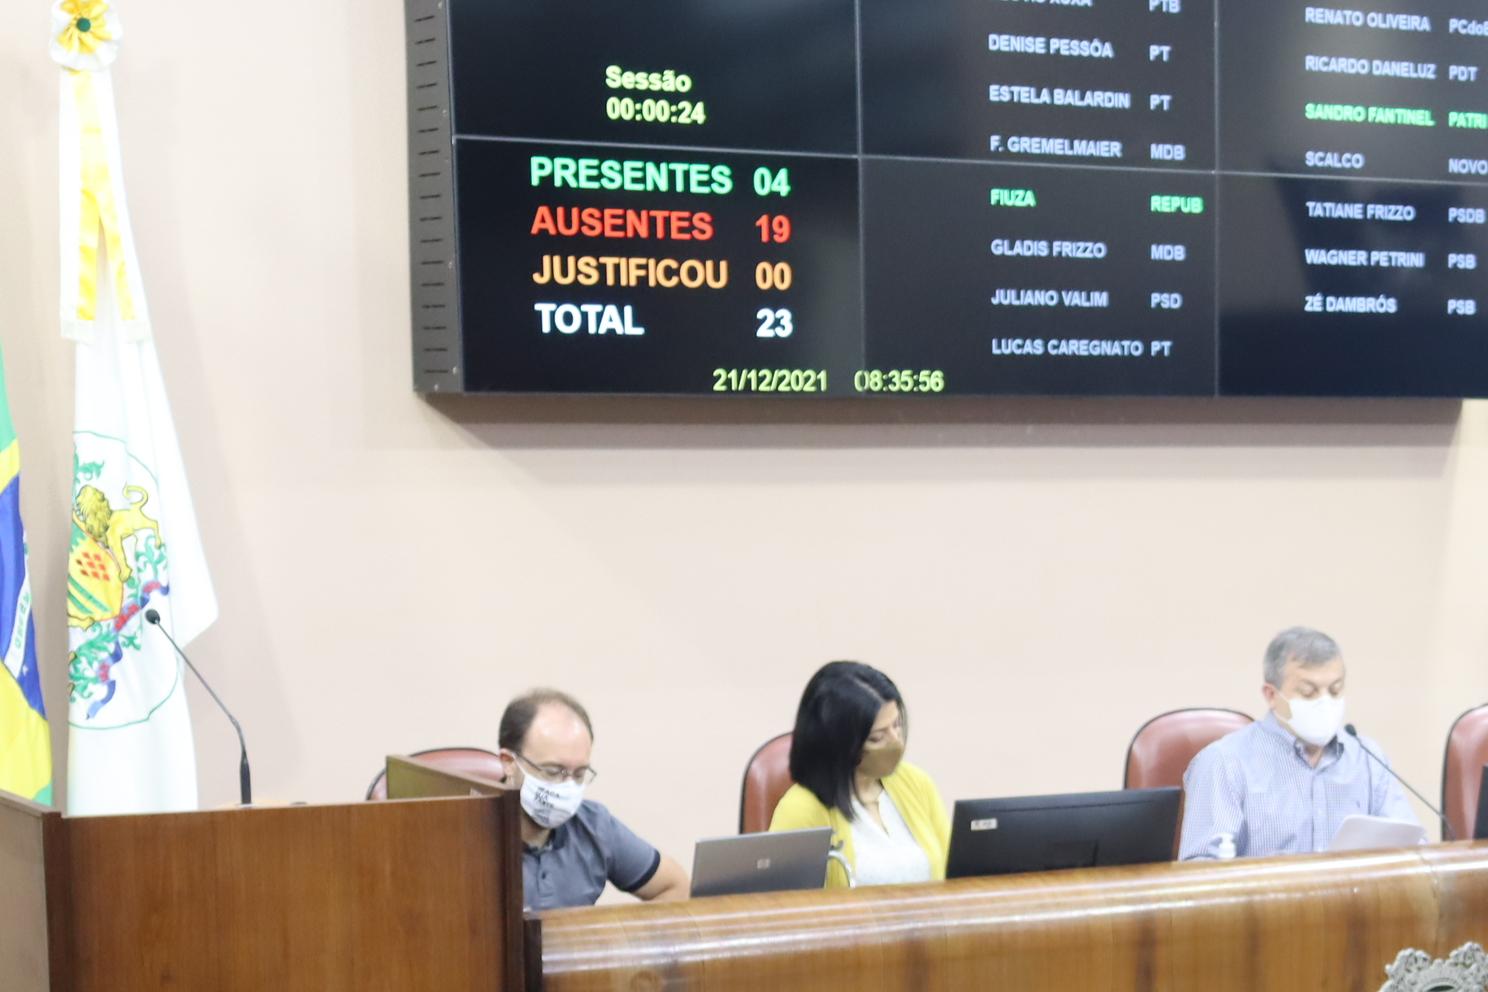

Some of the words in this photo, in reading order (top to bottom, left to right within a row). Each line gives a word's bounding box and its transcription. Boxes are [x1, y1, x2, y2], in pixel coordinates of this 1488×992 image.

[1305, 7, 1365, 26] RENATO
[1366, 12, 1430, 31] OLIVEIRA
[989, 34, 1046, 54] DENISE
[1150, 45, 1171, 61] PT
[606, 65, 692, 92] Sessão
[1305, 55, 1370, 74] RICARDO
[1372, 60, 1436, 79] DANELUZ
[1449, 65, 1477, 81] PDT
[989, 85, 1052, 104] ESTELA
[1054, 88, 1130, 108] BALARDIN
[1150, 94, 1171, 110] PT
[607, 97, 706, 124] 00:00:24
[1305, 103, 1366, 122] SANDRO
[1368, 107, 1435, 126] FANTINEL
[1449, 112, 1488, 129] PATRI
[990, 135, 1003, 151] F.
[1007, 136, 1122, 157] GREMELMAIER
[1151, 144, 1185, 160] MDB
[1306, 151, 1364, 168] SCALCO
[1449, 159, 1488, 174] NOVO
[531, 156, 733, 194] PRESENTES
[754, 167, 791, 196] 04
[991, 189, 1036, 206] FIUZA
[1151, 195, 1203, 213] REPUB
[1306, 201, 1364, 219] TATIANE
[1367, 204, 1416, 220] FRIZZO
[1449, 208, 1486, 223] PSDB
[531, 206, 713, 240] AUSENTES
[756, 215, 791, 243] 19
[991, 239, 1049, 256] GLADIS
[1053, 241, 1107, 258] FRIZZO
[1151, 244, 1185, 260] MDB
[1305, 249, 1368, 266] WAGNER
[1370, 251, 1425, 267] PETRINI
[1448, 253, 1476, 269] PSB
[533, 255, 728, 288] JUSTIFICOU
[756, 262, 791, 290] 00
[991, 289, 1059, 306] JULIANO
[1062, 291, 1108, 307] VALIM
[1151, 293, 1182, 308] PSD
[1305, 293, 1323, 311] ZÉ
[1326, 295, 1397, 313] DAMBRÓS
[1448, 299, 1476, 315] PSB
[534, 303, 645, 335] TOTAL
[757, 308, 793, 337] 23
[992, 339, 1044, 354] LUCAS
[1048, 339, 1144, 356] CAREGNATO
[1151, 341, 1172, 356] PT
[713, 369, 826, 391] 21/12/2021
[854, 370, 944, 392] 08:35:56
